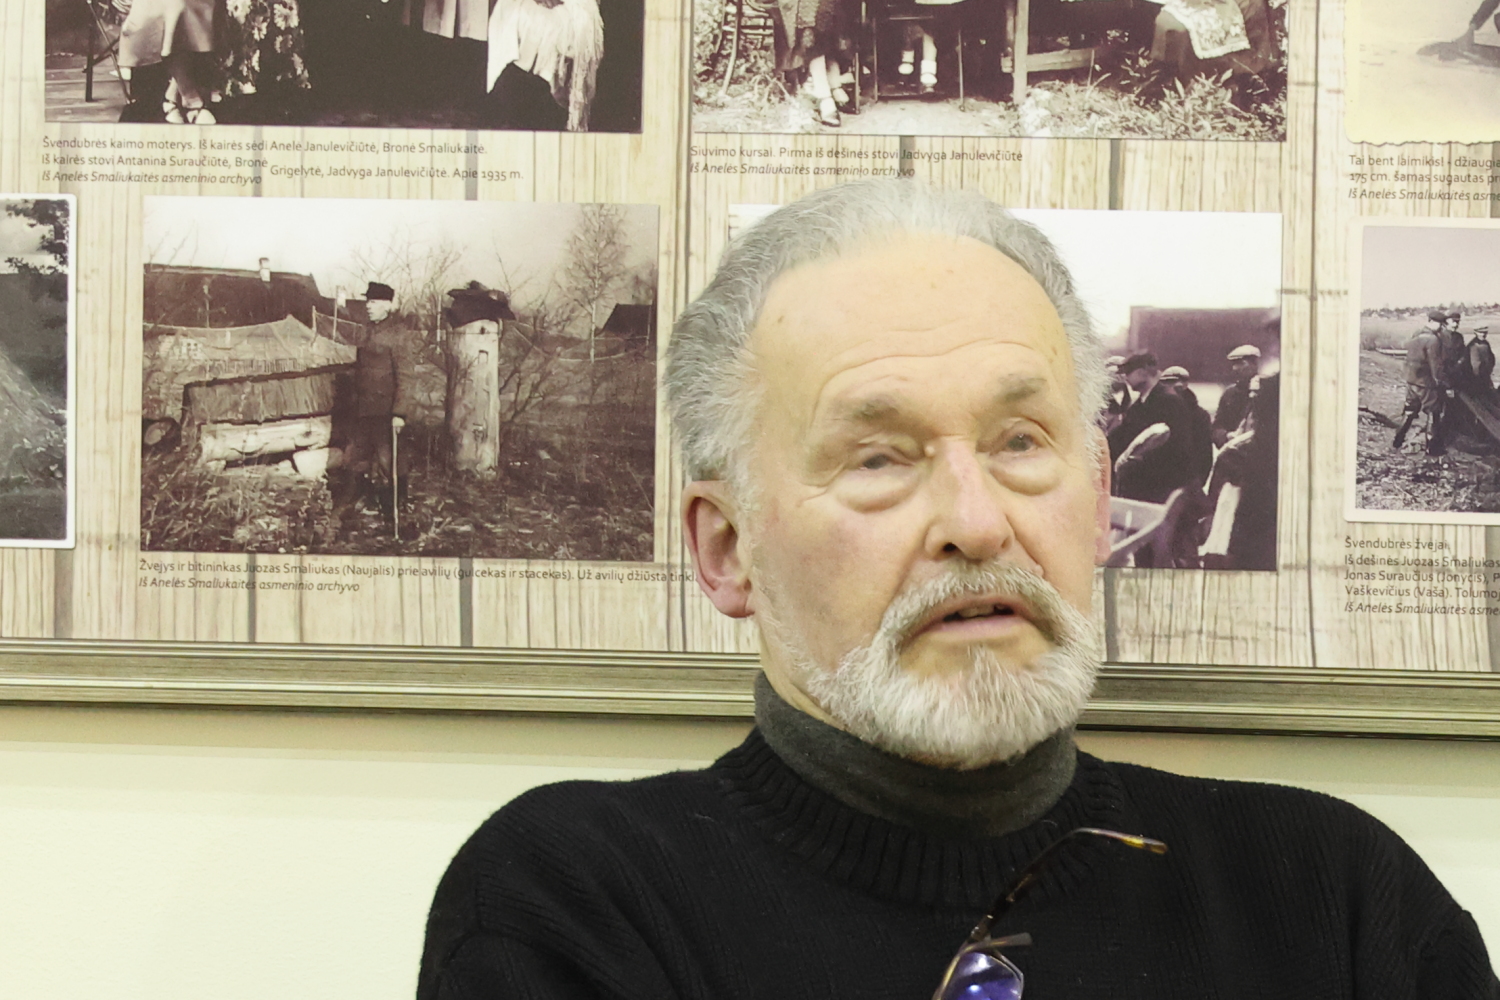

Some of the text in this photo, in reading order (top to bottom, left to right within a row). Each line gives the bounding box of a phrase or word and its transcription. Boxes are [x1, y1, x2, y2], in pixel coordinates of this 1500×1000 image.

[110, 138, 144, 149] kaimo
[147, 140, 196, 153] moterys.
[690, 146, 736, 157] Siuvimo
[780, 147, 812, 158] Pirma
[872, 148, 898, 159] stovi
[901, 150, 946, 163] Jadvyga
[1349, 155, 1364, 166] Tai
[1368, 156, 1393, 166] bent
[88, 155, 114, 165] stovi
[117, 156, 166, 166] Antanina
[327, 165, 372, 179] Jadvyga
[453, 168, 478, 180] Apie
[481, 170, 507, 181] 1935
[510, 170, 524, 179] m.
[813, 165, 869, 177] asmeninio
[872, 166, 915, 178] archyvo
[162, 173, 216, 184] asmeninio
[219, 174, 262, 187] archyvo
[1350, 173, 1367, 183] 175
[1370, 173, 1390, 182] cm.
[1433, 173, 1484, 185] sugautas
[1401, 556, 1439, 567] Juozas
[1442, 556, 1500, 568] Smaliukas
[178, 561, 184, 571] ir
[188, 561, 241, 572] bitininkas
[243, 562, 280, 573] Juozas
[283, 563, 339, 574] Smaliukas
[343, 564, 395, 578] (Naujalis)
[398, 566, 418, 578] prie
[509, 568, 517, 578] ir
[1344, 570, 1376, 580] Jonas
[260, 579, 314, 590] asmeninio
[317, 580, 360, 594] archyvo
